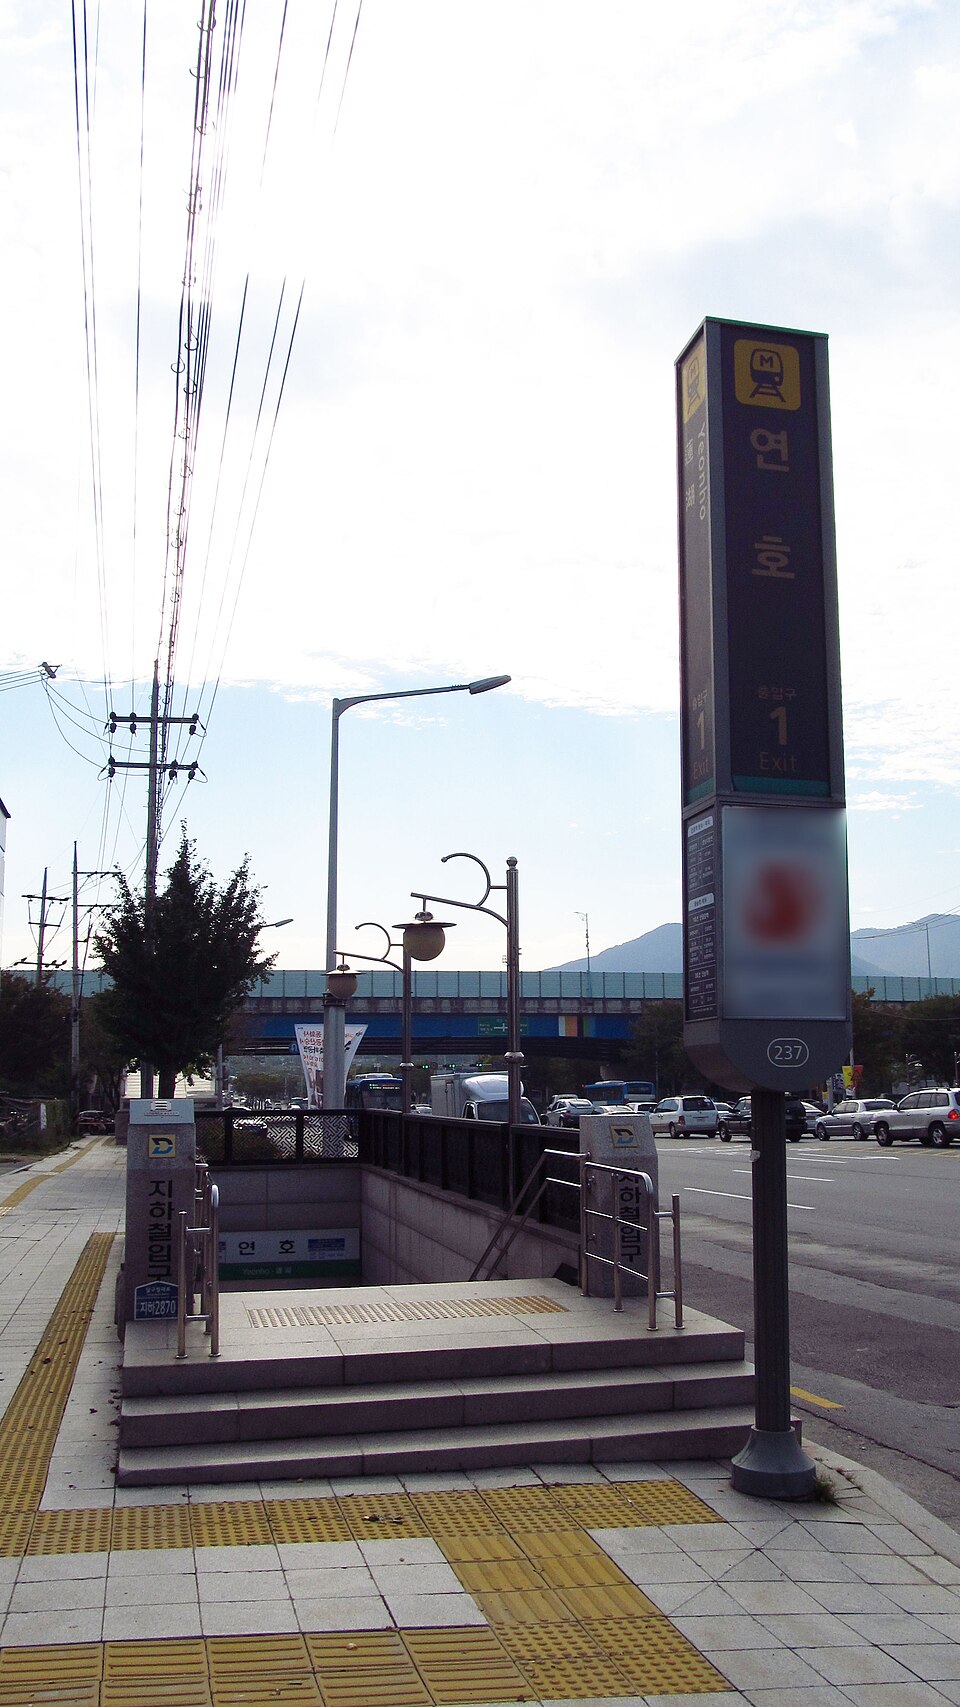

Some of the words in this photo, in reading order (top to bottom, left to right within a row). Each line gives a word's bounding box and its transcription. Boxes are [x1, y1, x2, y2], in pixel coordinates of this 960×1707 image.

[697, 420, 707, 521] Yeonho
[696, 710, 706, 750] 1
[769, 706, 788, 746] 1
[759, 751, 798, 772] Exit
[773, 1045, 803, 1061] 237
[140, 1299, 176, 1317] 지하2870
